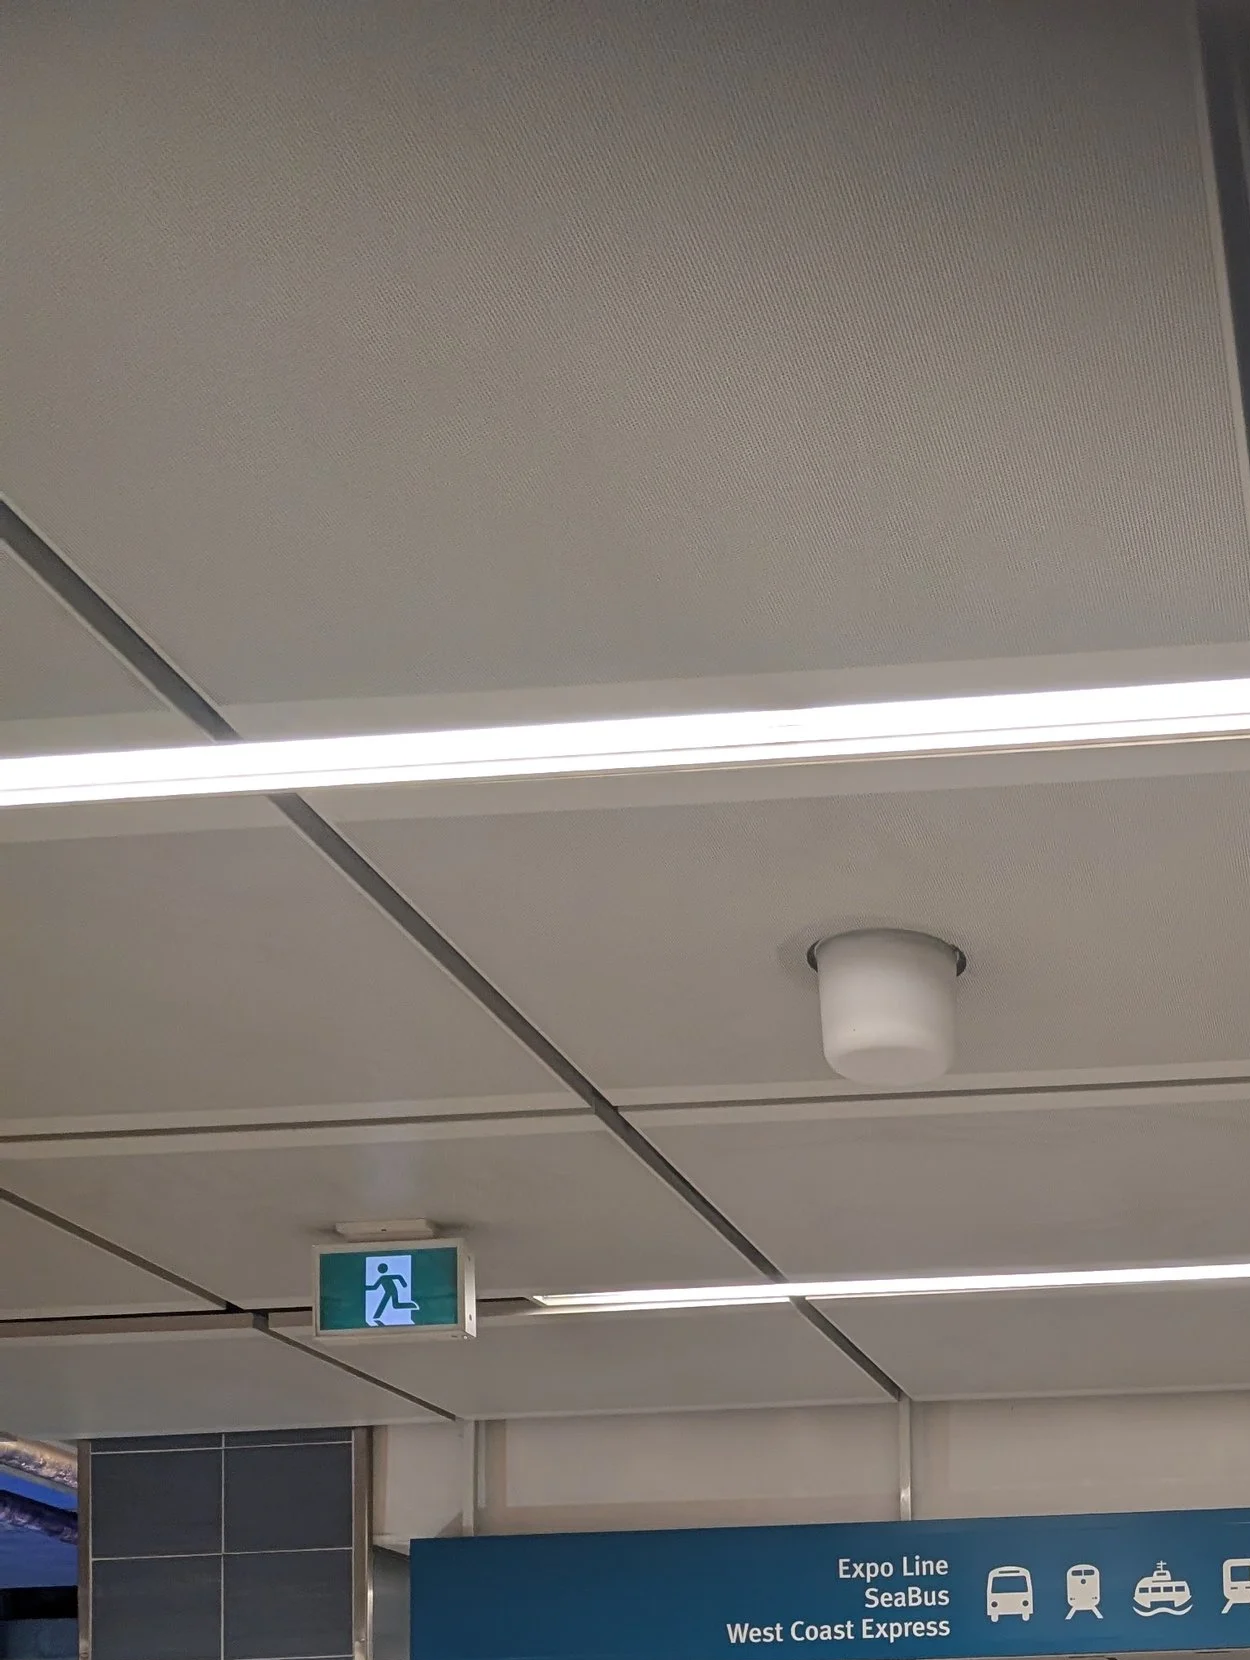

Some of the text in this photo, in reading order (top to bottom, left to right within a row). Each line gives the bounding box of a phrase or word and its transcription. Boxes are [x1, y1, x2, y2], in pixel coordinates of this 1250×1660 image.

[839, 1555, 948, 1583] Expo Line
[865, 1587, 949, 1608] SeaBus
[727, 1619, 950, 1643] West Coast Express
